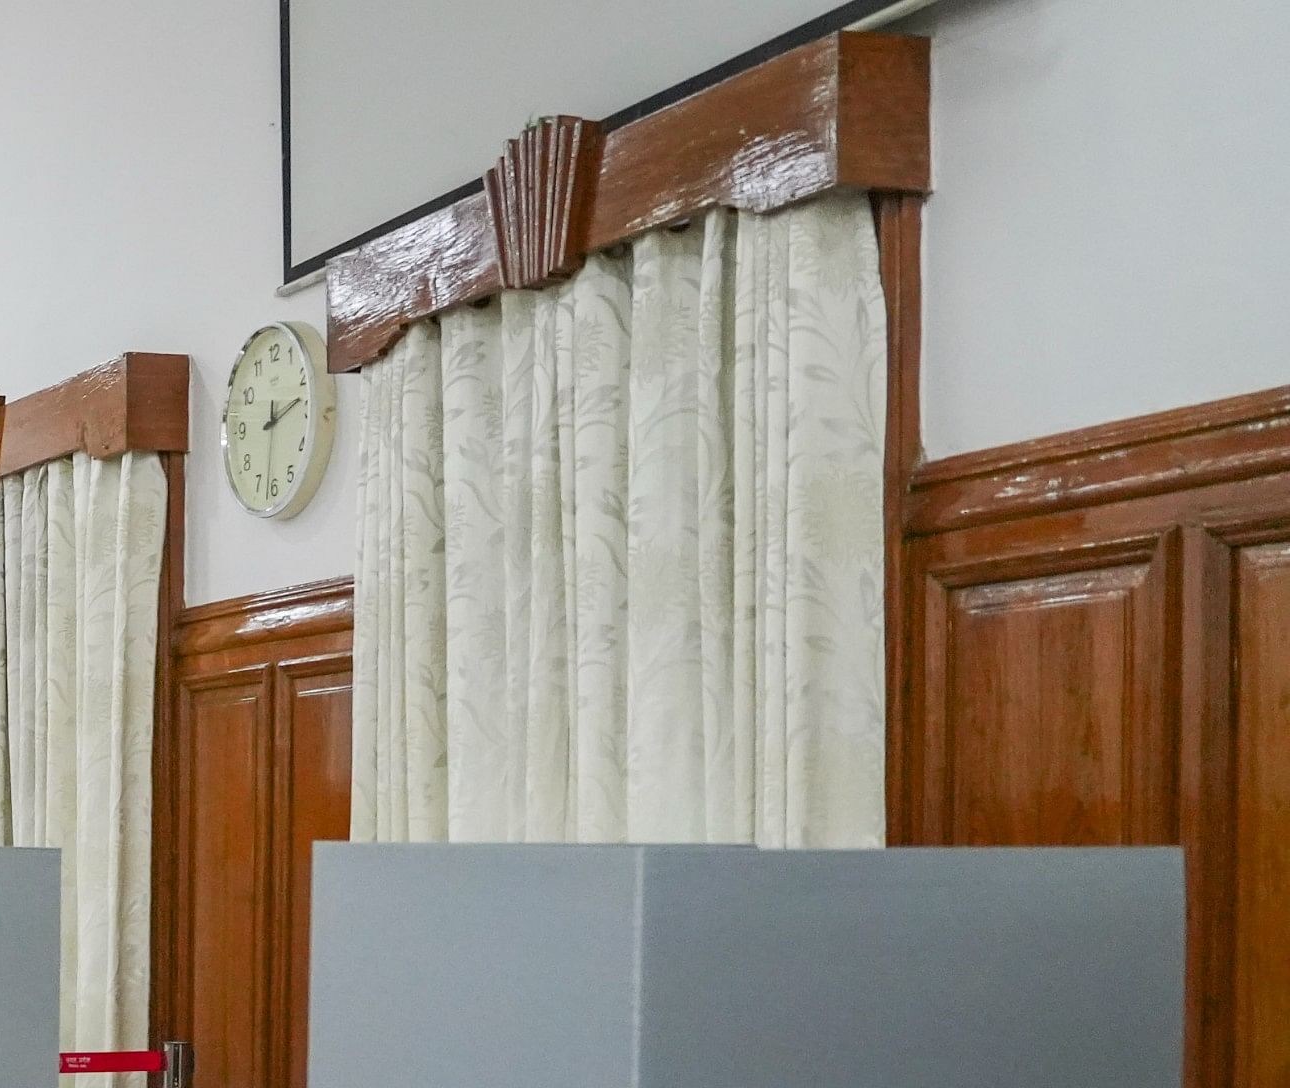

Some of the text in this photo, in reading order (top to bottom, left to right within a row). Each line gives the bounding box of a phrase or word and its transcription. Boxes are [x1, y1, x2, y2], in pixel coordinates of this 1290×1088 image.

[269, 343, 280, 362] 12
[288, 347, 293, 365] 1
[254, 359, 262, 377] 11
[300, 367, 307, 386] 2
[243, 386, 255, 406] 10
[239, 422, 246, 440] 9
[244, 454, 251, 471] 8
[256, 474, 262, 492] 7
[287, 465, 294, 483] 5
[271, 479, 278, 496] 6
